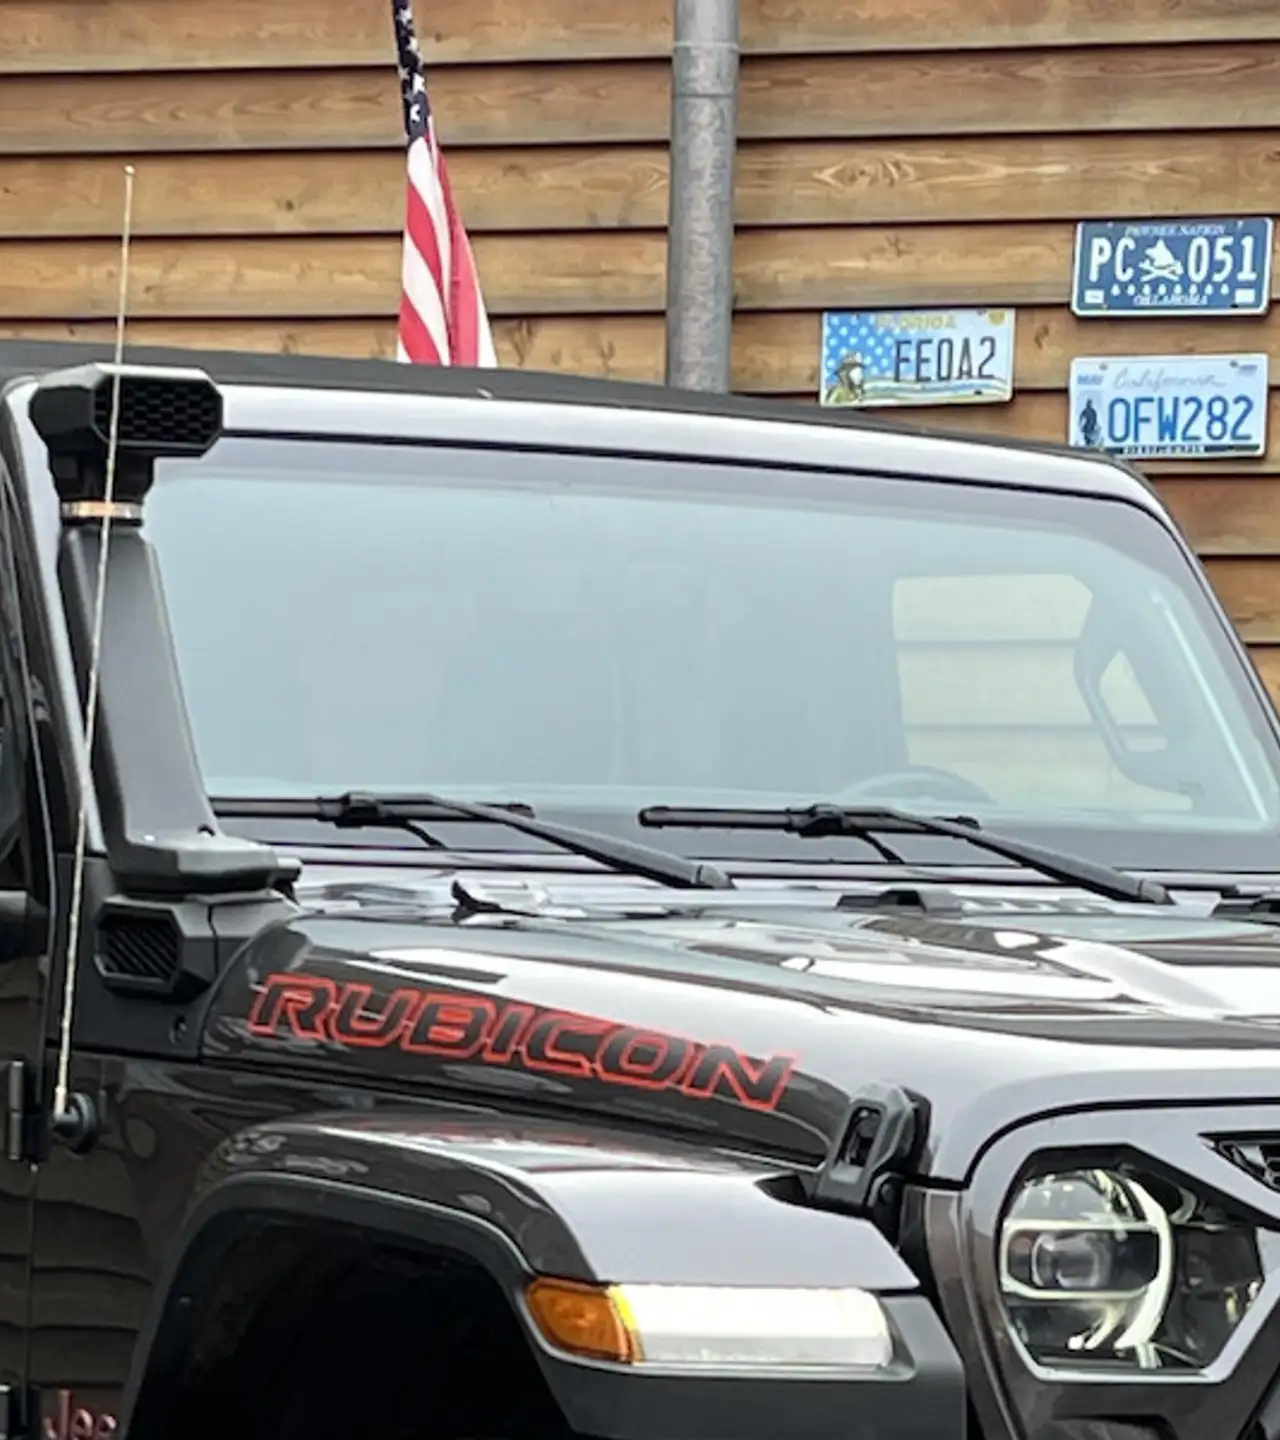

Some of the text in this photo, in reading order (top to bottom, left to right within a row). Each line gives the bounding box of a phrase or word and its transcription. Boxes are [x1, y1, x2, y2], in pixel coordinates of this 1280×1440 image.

[1089, 235, 1257, 282] PC 051
[249, 972, 801, 1112] RUBICON
